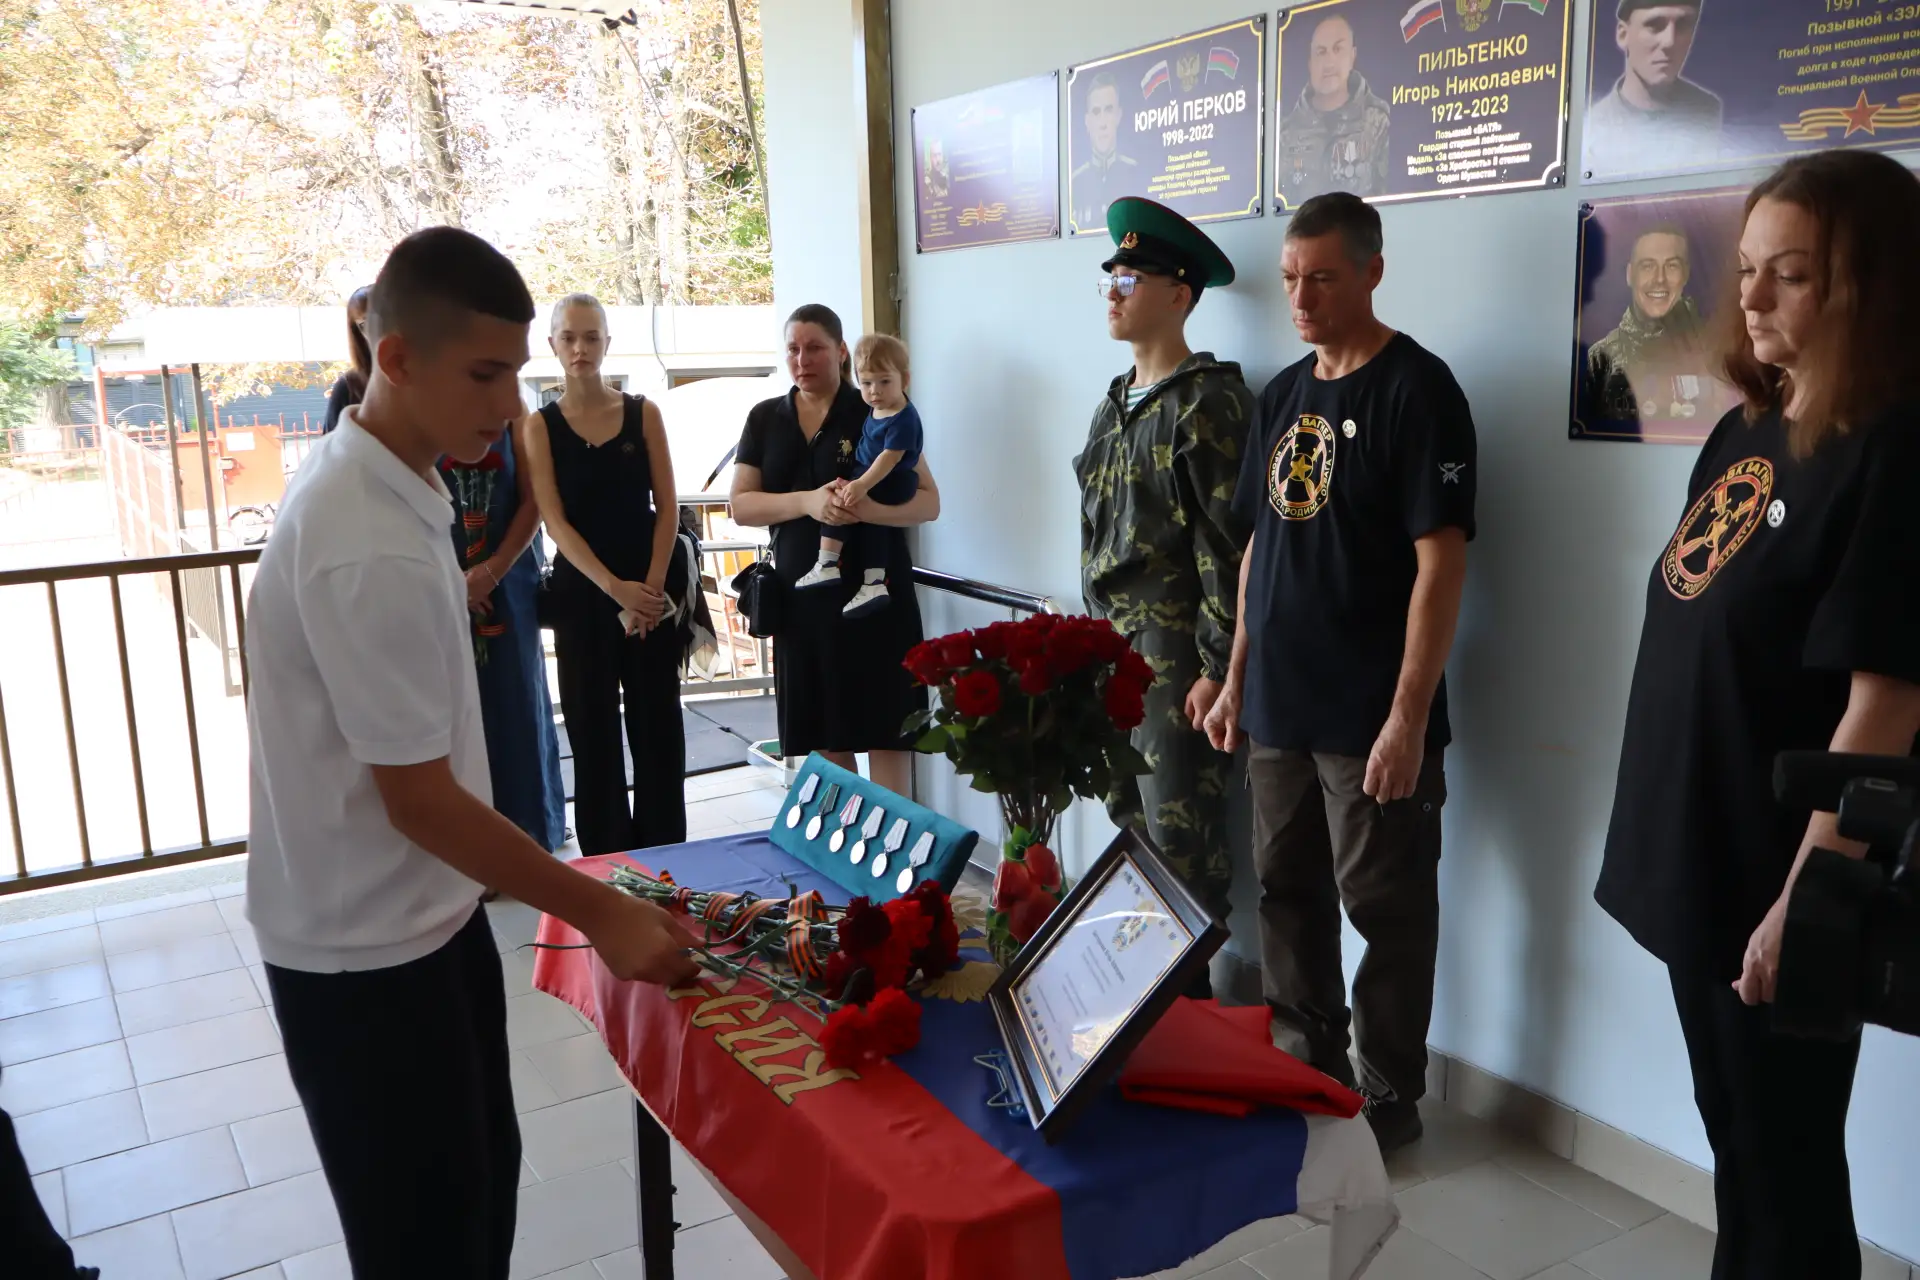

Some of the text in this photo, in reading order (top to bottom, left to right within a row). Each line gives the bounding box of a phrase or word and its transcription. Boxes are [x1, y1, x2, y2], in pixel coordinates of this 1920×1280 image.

[1808, 11, 1882, 36] Позывной
[1418, 34, 1529, 75] ПИЛЬТЕНКО
[1778, 44, 1810, 60] Погиб
[1812, 43, 1832, 56] при
[1834, 31, 1900, 50] исполнении
[1797, 62, 1829, 77] долга
[1831, 61, 1838, 70] в
[1840, 56, 1867, 69] ходе
[1392, 63, 1557, 106] Игорь Николаевич
[1777, 75, 1848, 96] Специальной
[1850, 68, 1898, 86] Военной
[1134, 89, 1247, 133] ЮРИЙ ПЕРКОВ
[1431, 94, 1510, 124] 1972-2023
[1162, 122, 1214, 147] 1998-2022
[1301, 417, 1332, 442] ВАГНЕР
[1745, 461, 1770, 495] ВАГНЕР
[1665, 548, 1679, 586] ЧЕСТЬ
